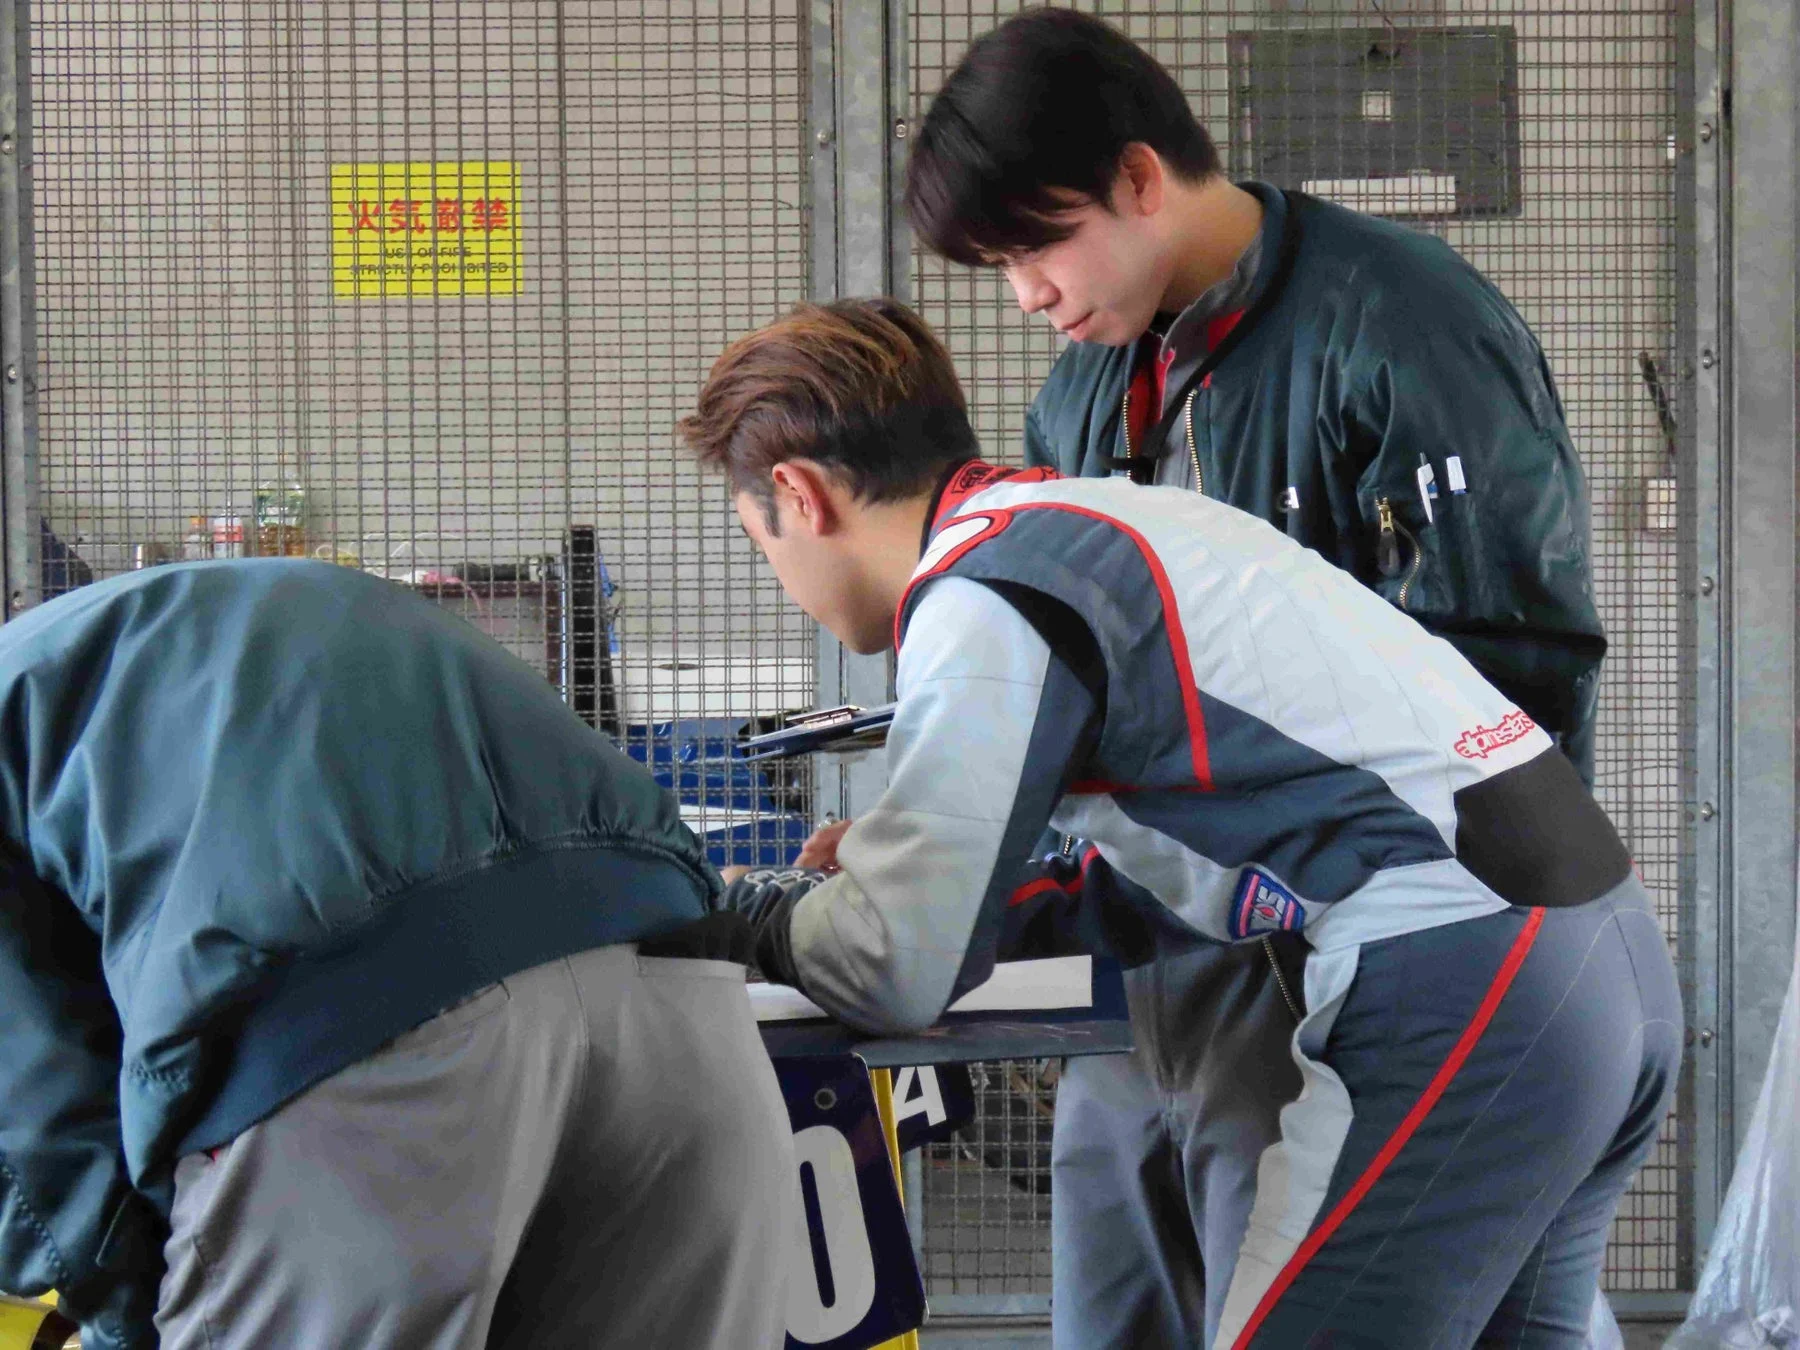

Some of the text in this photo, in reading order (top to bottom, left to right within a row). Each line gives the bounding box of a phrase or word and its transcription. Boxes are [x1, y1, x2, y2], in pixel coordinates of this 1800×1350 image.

[383, 247, 411, 259] US
[350, 262, 508, 276] STRCTLY POHBITED
